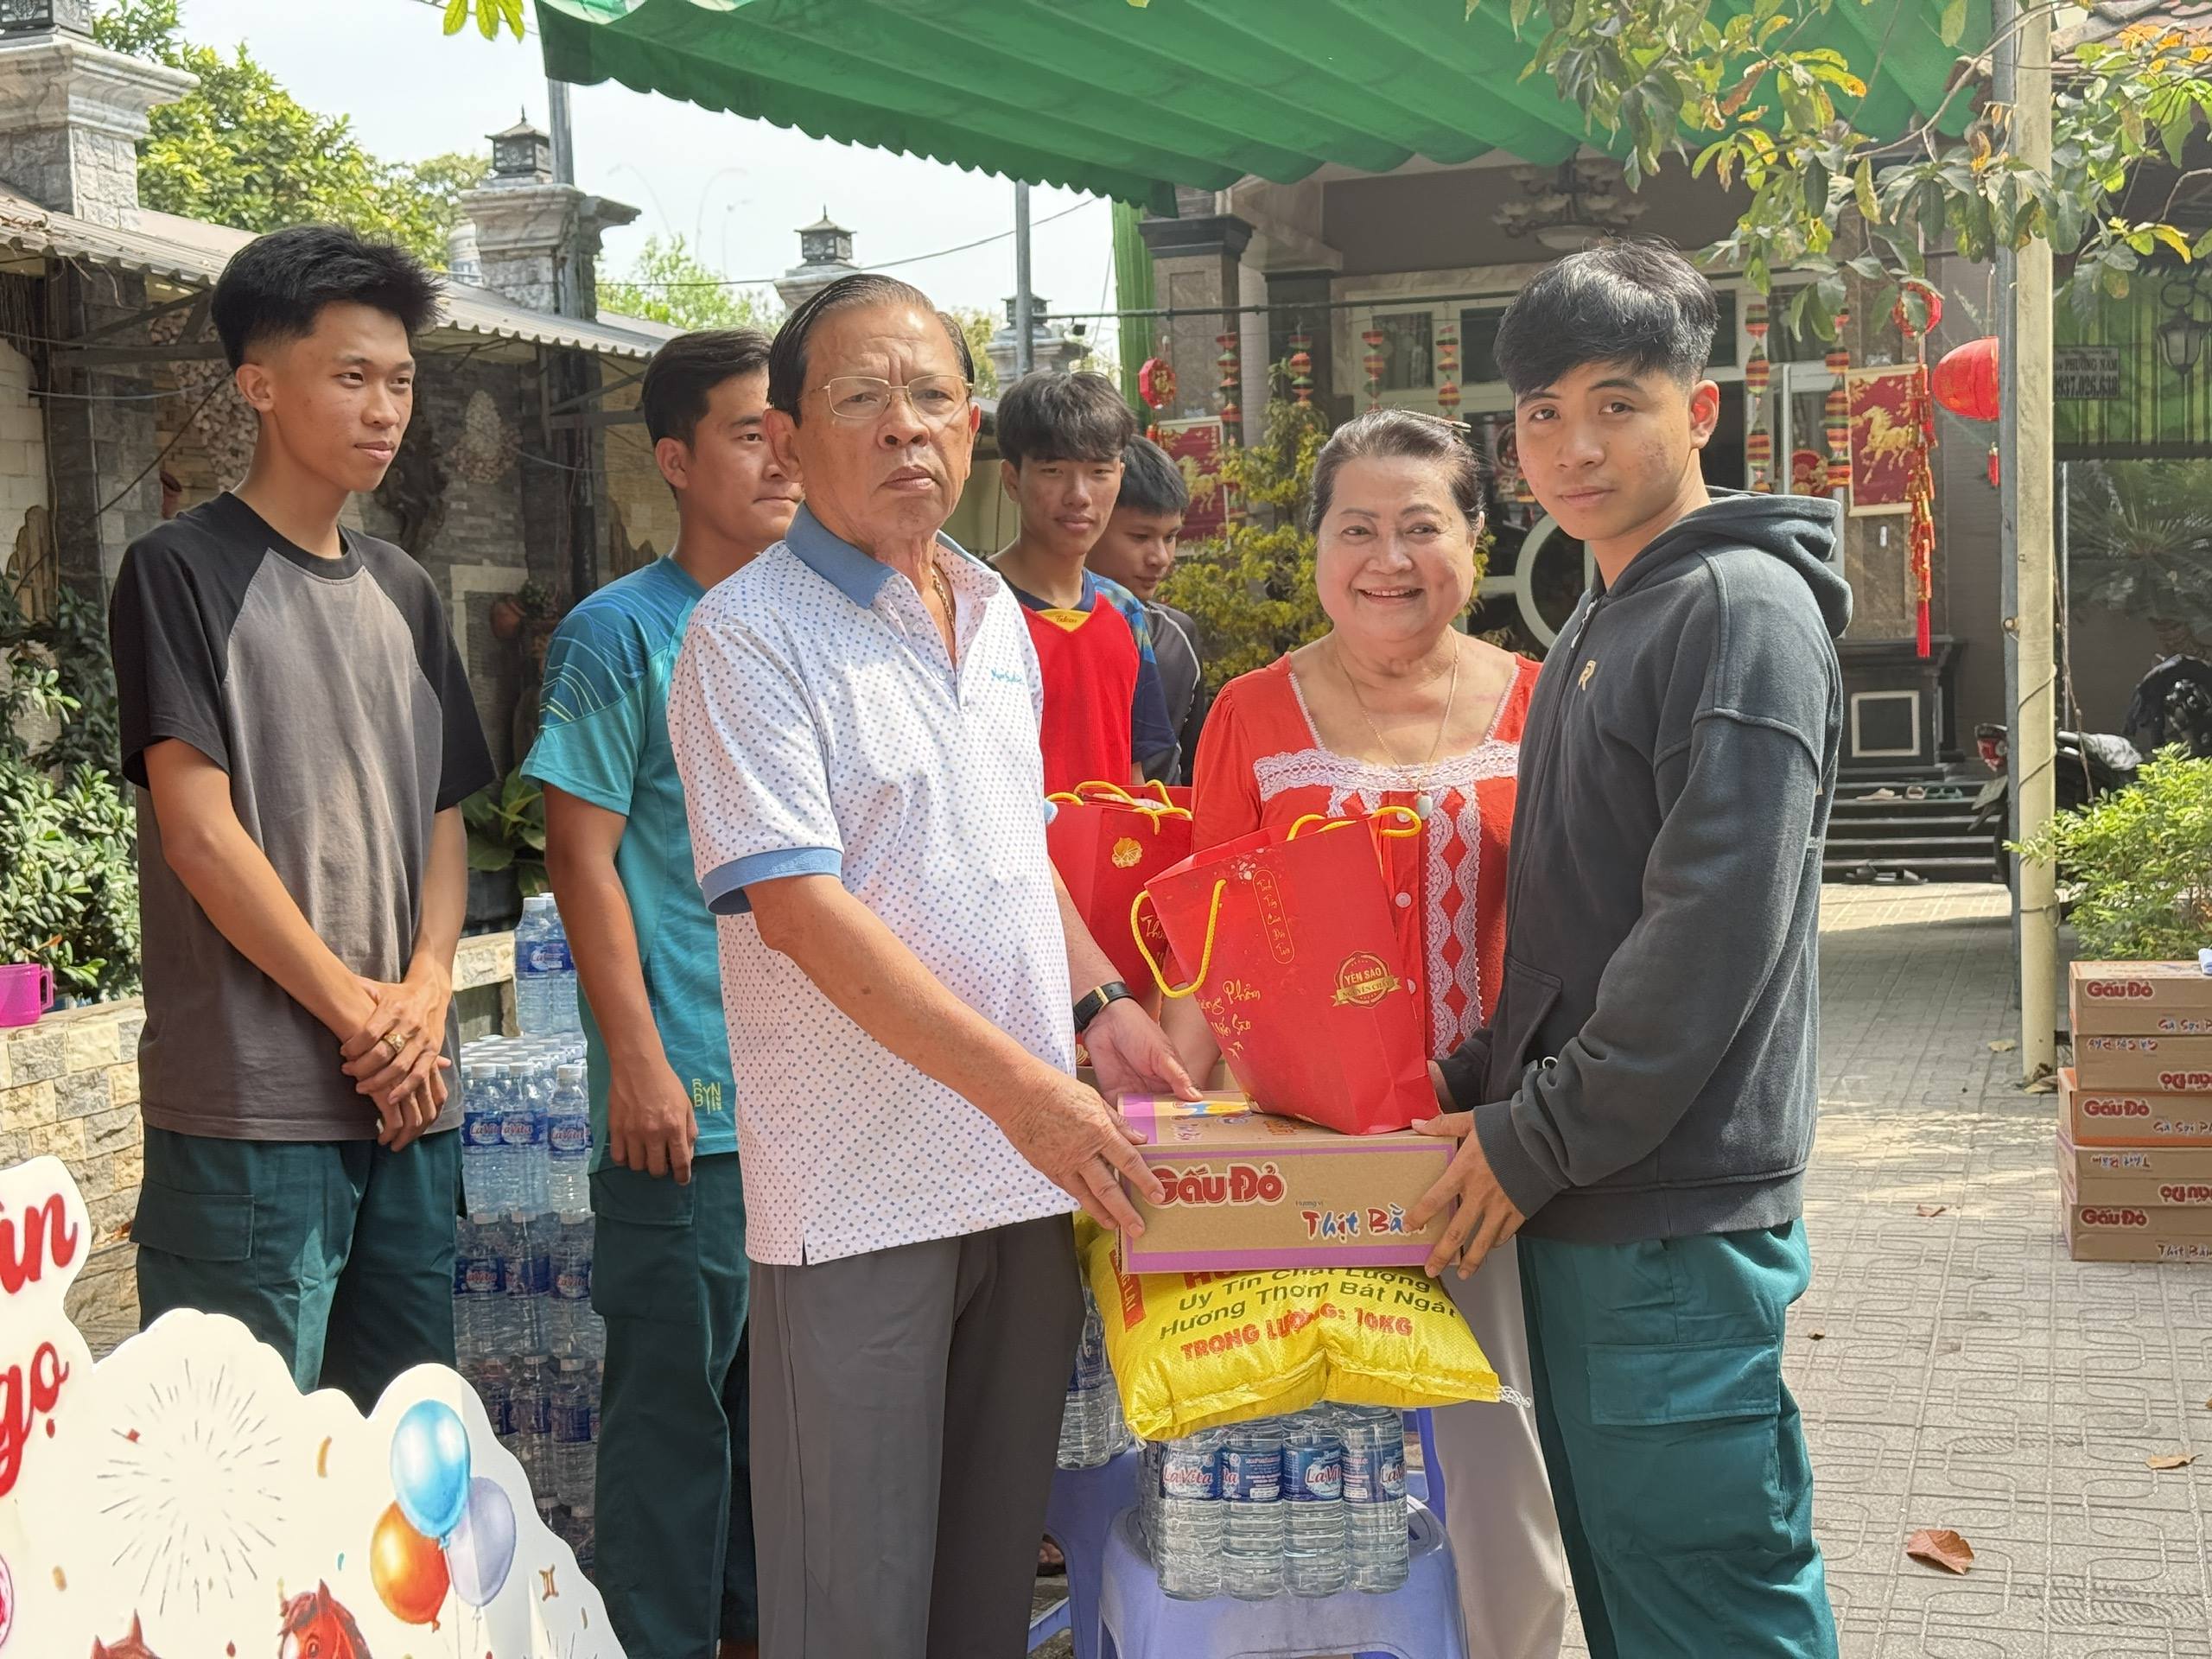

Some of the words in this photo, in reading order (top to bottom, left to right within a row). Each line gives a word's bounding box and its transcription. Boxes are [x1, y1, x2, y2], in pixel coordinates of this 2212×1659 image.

[1300, 1210, 1359, 1241] Thịt
[1366, 1203, 1426, 1234] Bằ
[1160, 1300, 1246, 1340] Hương
[1255, 1281, 1329, 1306] Thơm
[1179, 1290, 1213, 1311] Uy
[1222, 1276, 1262, 1296] Tín
[1180, 1323, 1260, 1362] TRỌNG
[1354, 1306, 1414, 1337] 10KG
